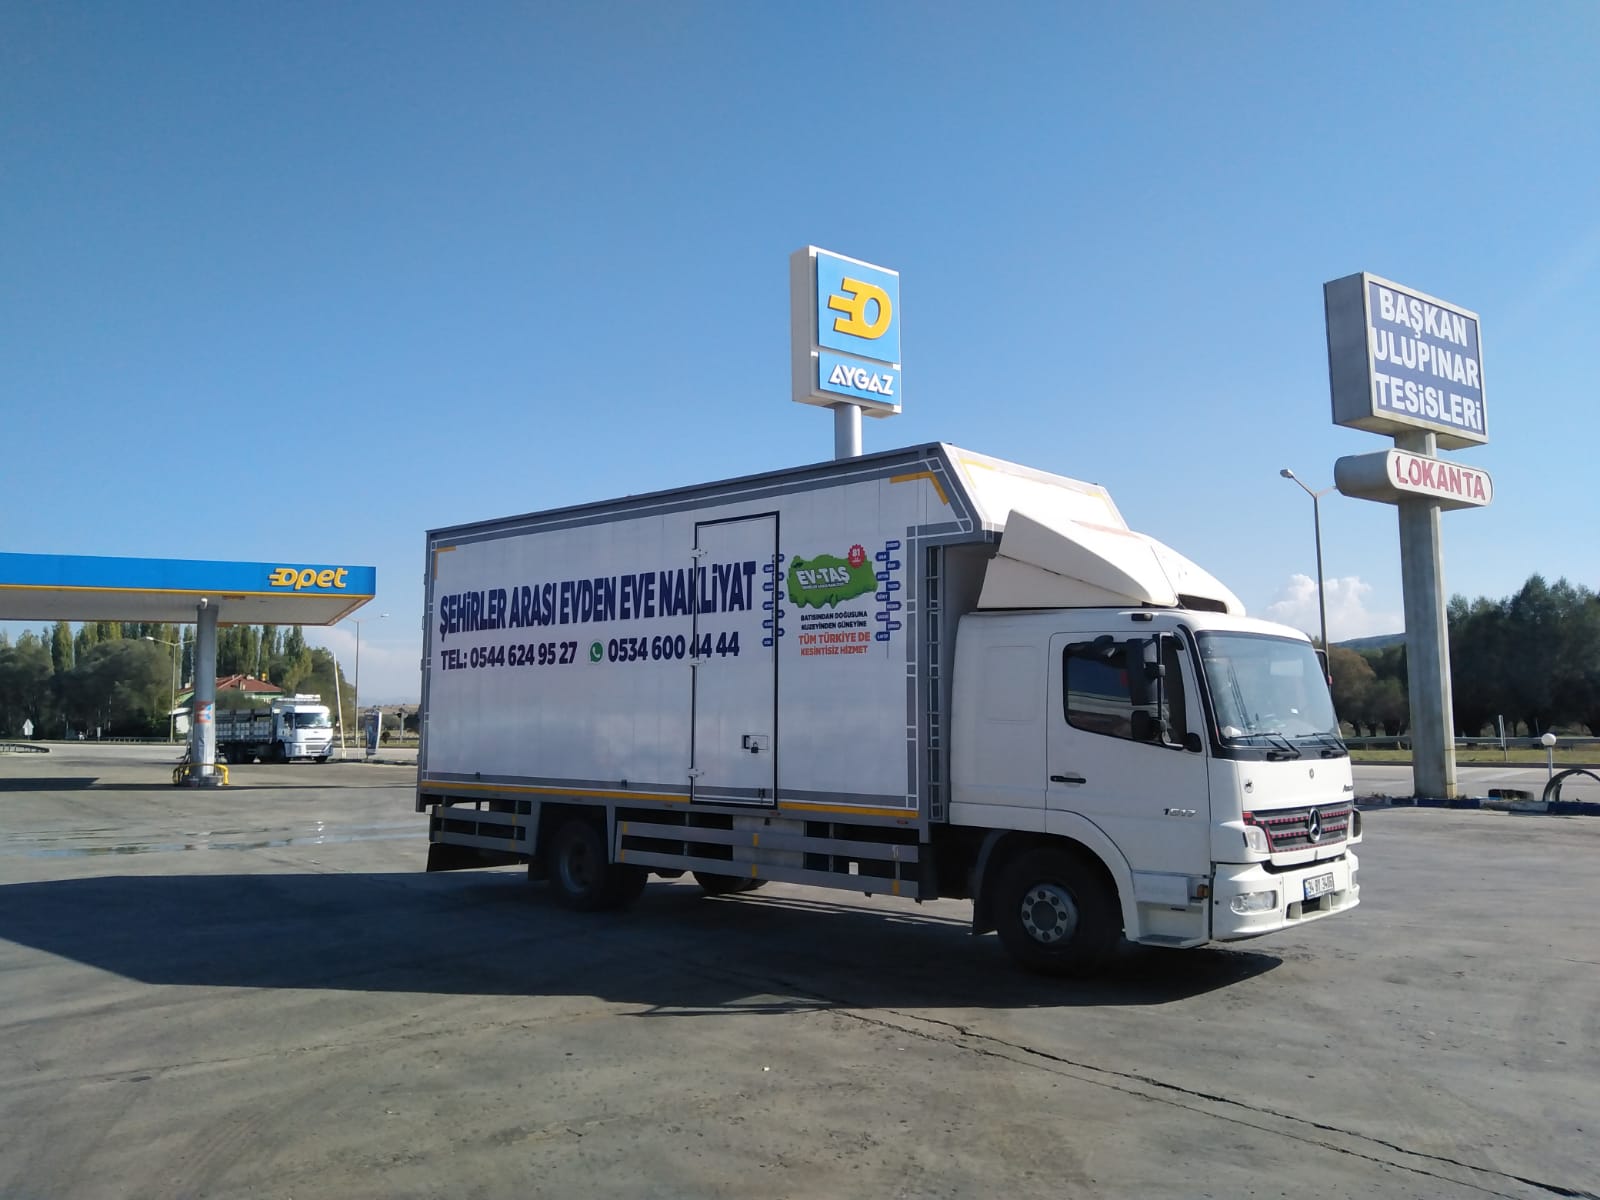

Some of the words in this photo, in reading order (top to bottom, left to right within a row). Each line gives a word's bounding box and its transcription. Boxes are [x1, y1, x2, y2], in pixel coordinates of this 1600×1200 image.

[1379, 287, 1468, 347] BAŞKAN
[829, 364, 894, 396] AYGAZ
[1371, 326, 1480, 389] ULUPINAR
[1395, 455, 1486, 501] LOKANTA
[509, 582, 557, 628] ARASI
[560, 576, 617, 625] EVDEN
[620, 572, 656, 620] EVE
[441, 650, 467, 671] TEL:
[470, 645, 505, 669] 0544
[508, 643, 535, 667] 624
[538, 642, 556, 666] 95
[559, 641, 578, 665] 27
[608, 637, 648, 663] 0534
[652, 634, 686, 661] 600
[716, 631, 740, 658] 44
[799, 633, 817, 645] TÜM
[818, 631, 857, 644] TÜRKİYE
[858, 632, 871, 642] DE
